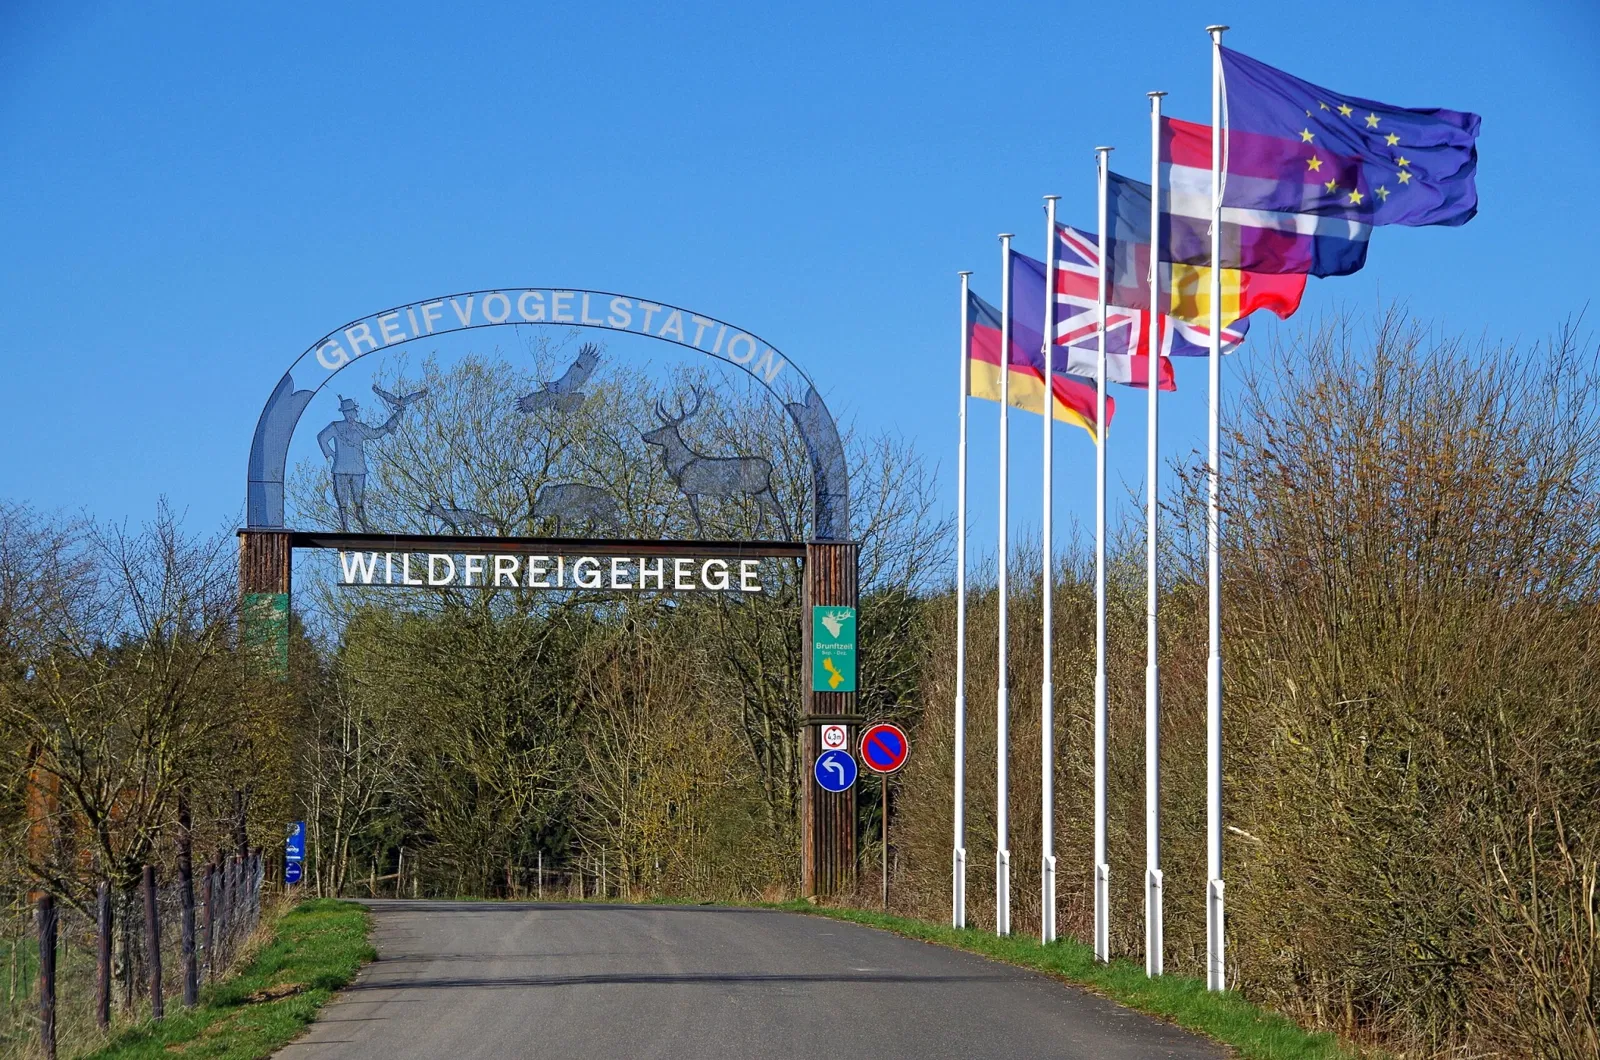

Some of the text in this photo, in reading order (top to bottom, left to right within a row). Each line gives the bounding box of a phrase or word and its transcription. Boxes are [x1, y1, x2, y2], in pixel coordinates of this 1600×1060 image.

[315, 290, 786, 384] GREIFVOGELSTATION
[340, 551, 763, 592] WILDFREIGEHEGE
[815, 642, 853, 650] Brunftzeit
